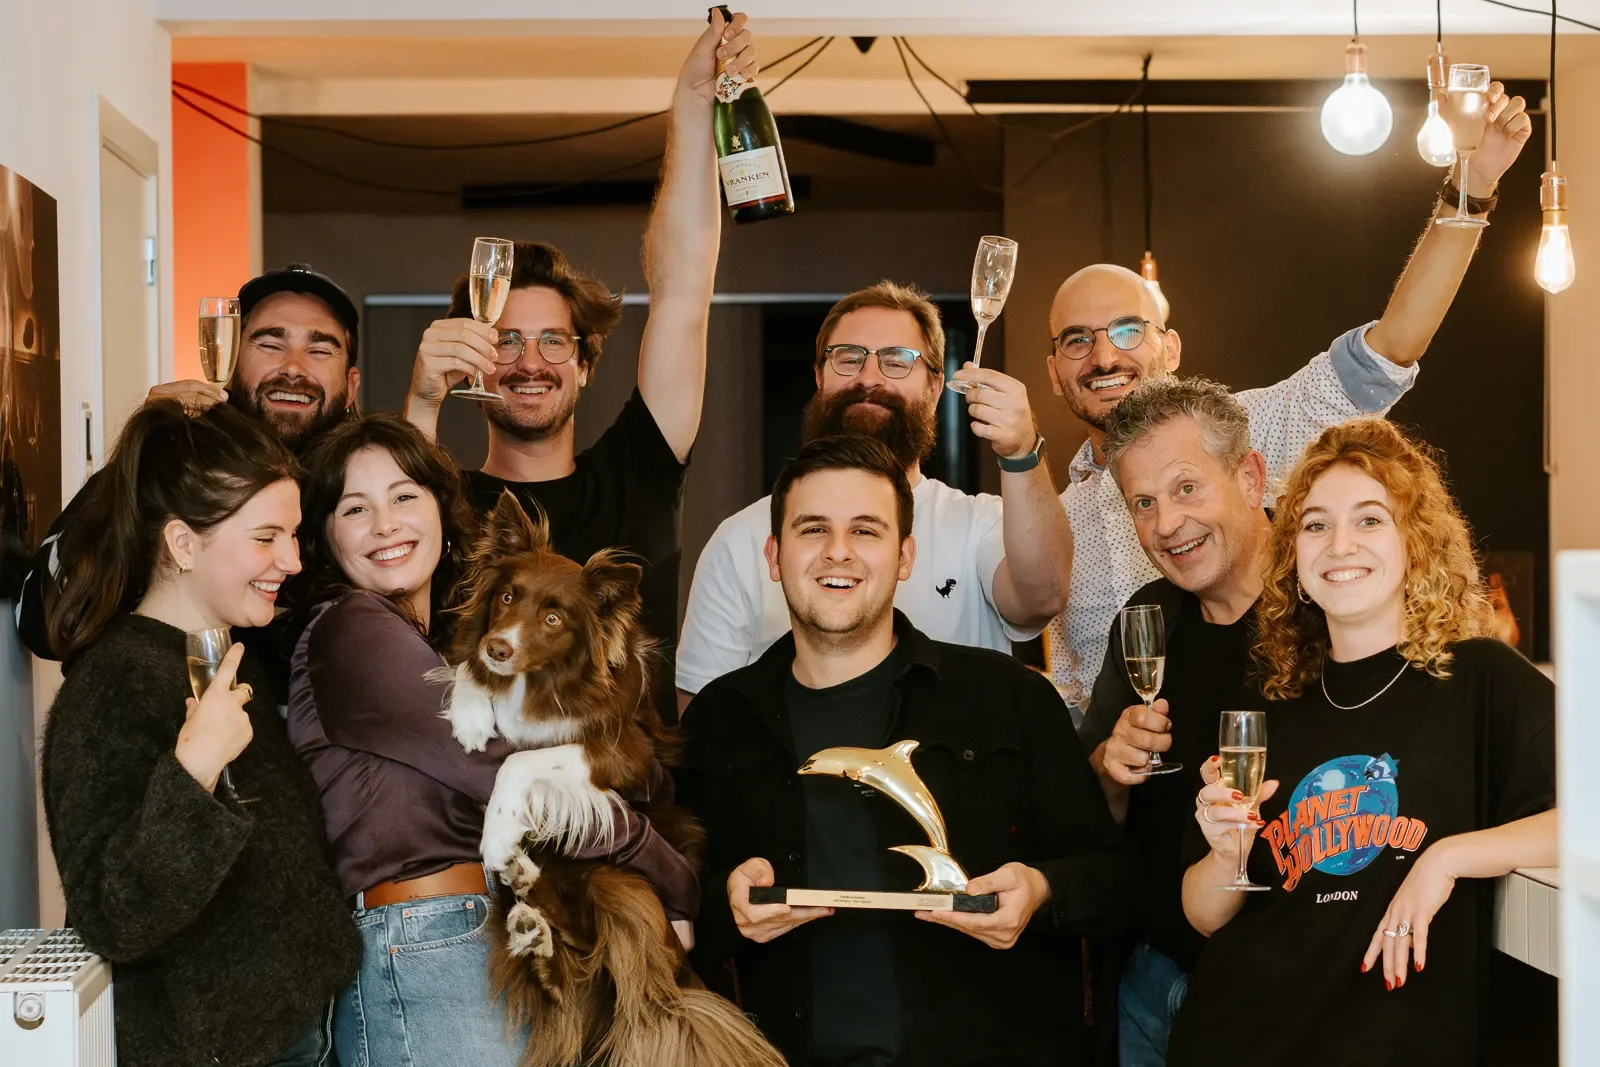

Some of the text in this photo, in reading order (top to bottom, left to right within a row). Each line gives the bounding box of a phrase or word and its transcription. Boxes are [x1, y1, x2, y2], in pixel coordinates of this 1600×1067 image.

[725, 171, 770, 186] VRANKEN
[1260, 784, 1369, 876] PLANET
[1281, 813, 1428, 893] HOLLYWOOD
[1315, 890, 1359, 904] LONDON
